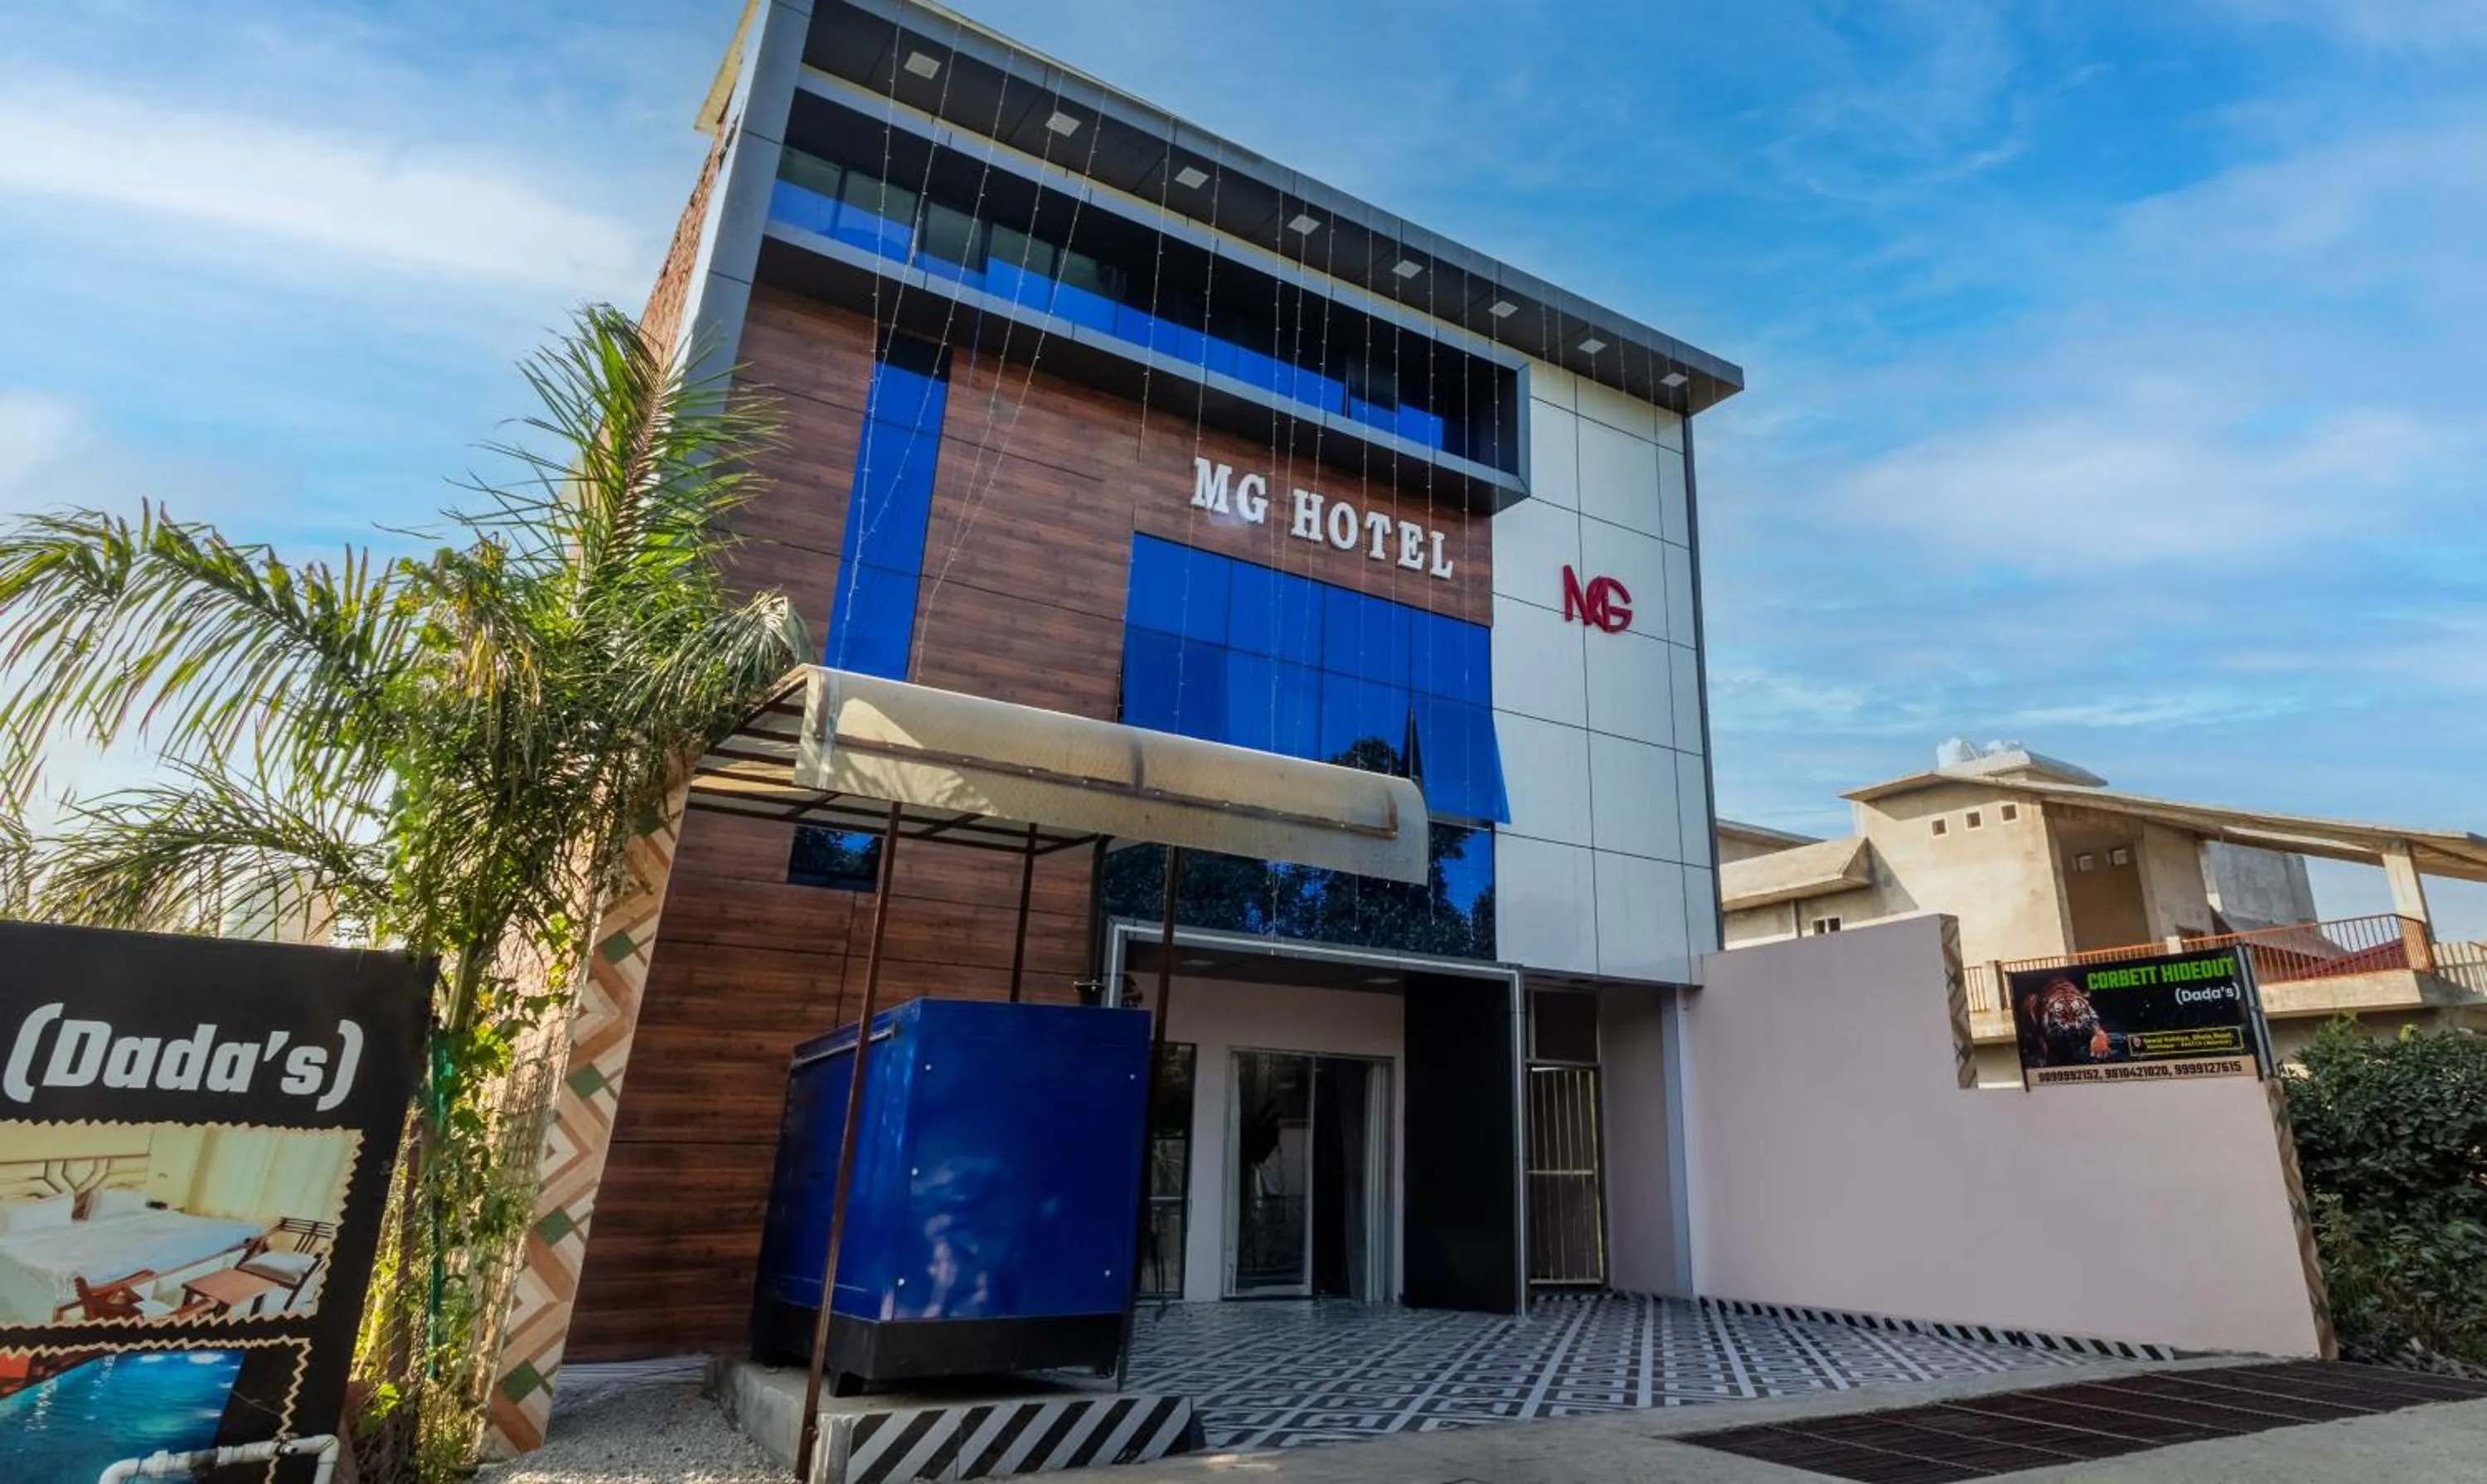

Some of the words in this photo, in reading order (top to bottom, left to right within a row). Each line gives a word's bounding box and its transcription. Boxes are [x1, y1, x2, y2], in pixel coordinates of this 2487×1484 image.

[1191, 457, 1268, 524] MG
[1290, 487, 1454, 580] HOTEL
[2087, 966, 2157, 990] CORBETT
[2160, 956, 2235, 982] HIDEOUT
[2174, 982, 2241, 1006] (Dada's)
[3, 1001, 365, 1113] (Dada's)
